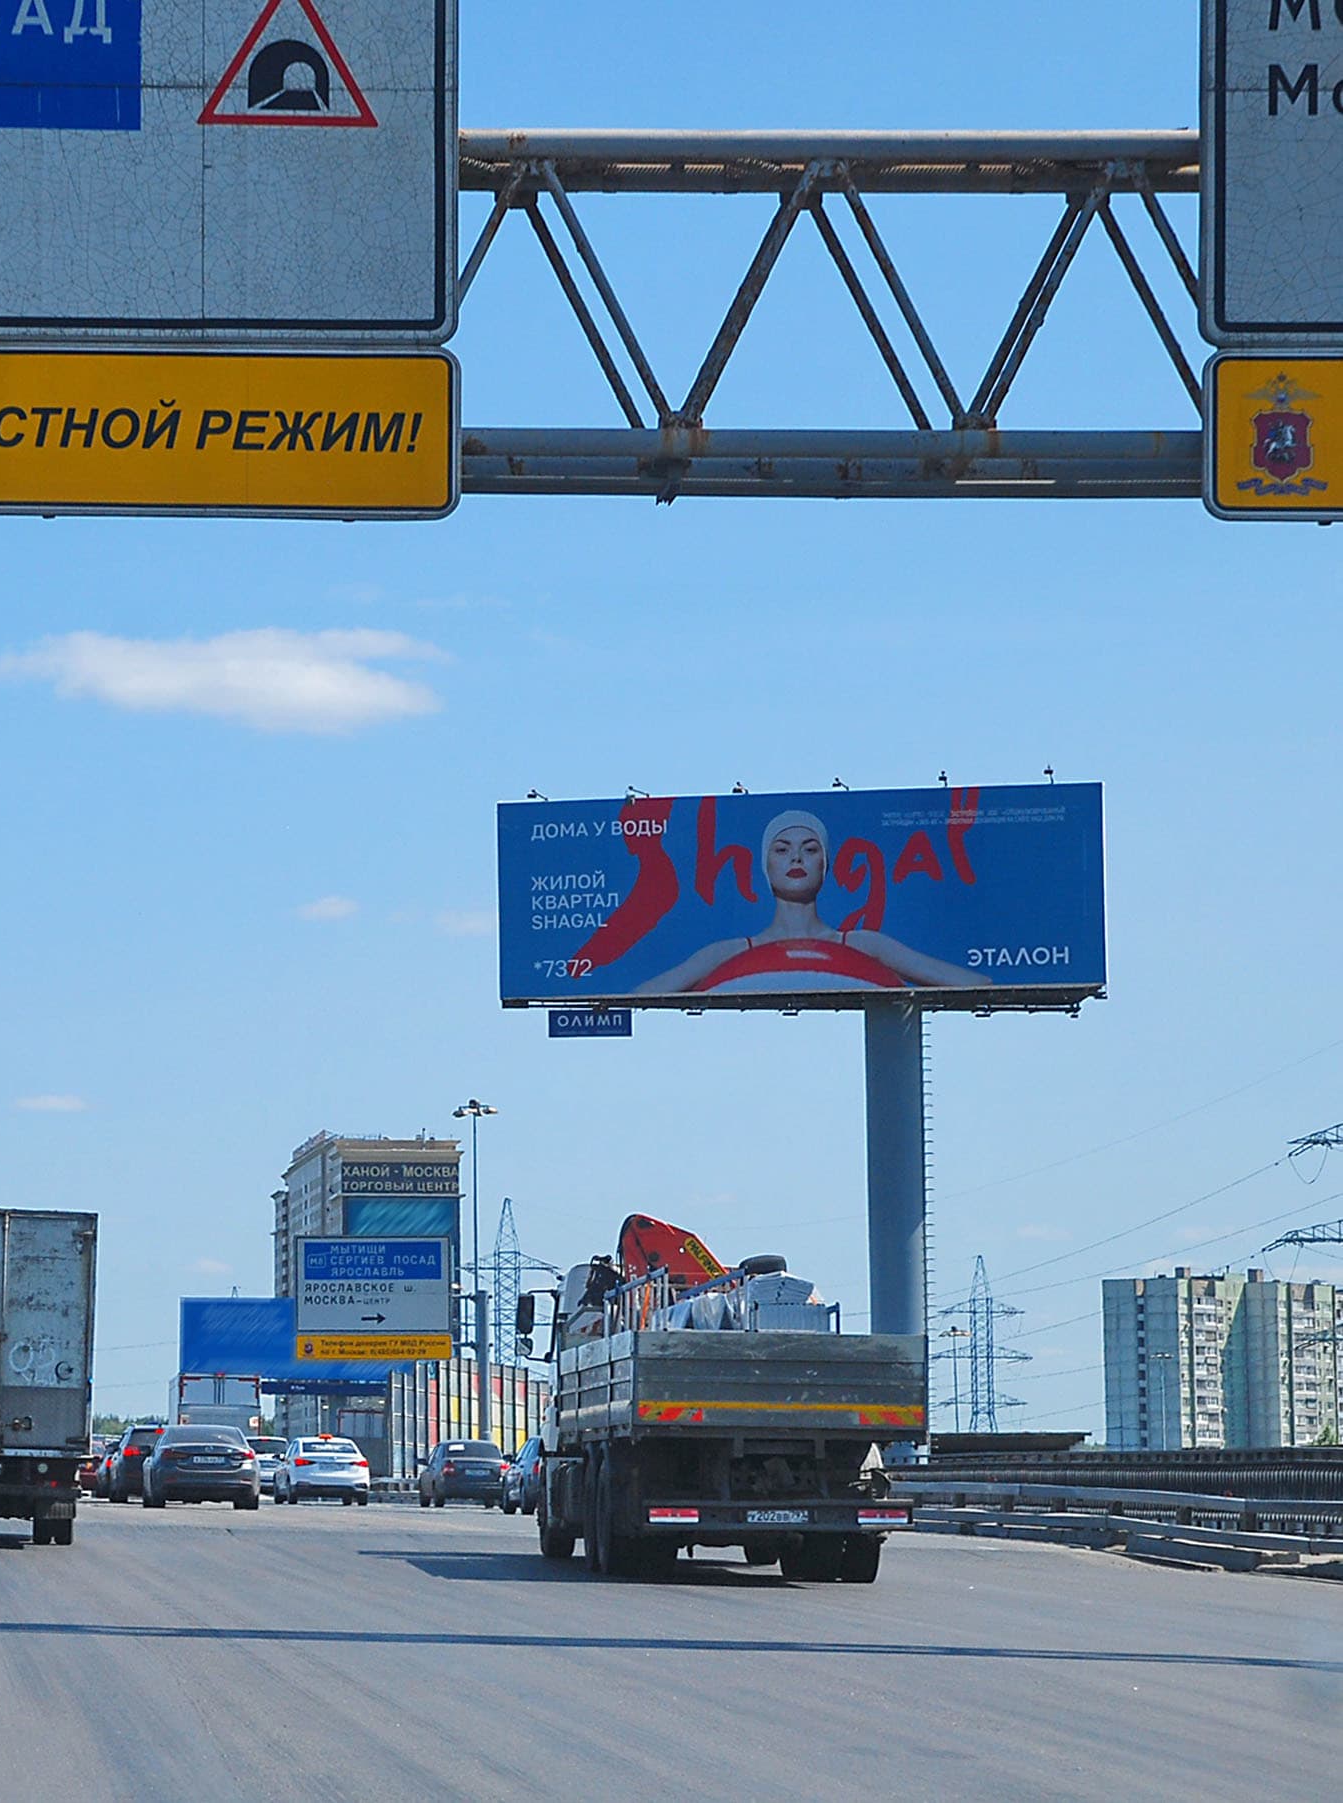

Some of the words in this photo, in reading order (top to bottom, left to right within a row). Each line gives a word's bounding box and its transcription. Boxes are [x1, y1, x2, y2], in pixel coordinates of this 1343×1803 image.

[196, 409, 423, 455] РЕЖИМ!
[531, 822, 589, 841] ДОМА
[592, 821, 606, 837] У
[611, 819, 668, 837] ВОДЫ
[531, 870, 606, 891] ЖИЛОЙ
[531, 892, 619, 911] КВАРТАЛ
[531, 912, 608, 930] SHAGAL
[967, 945, 1070, 967] ЭТАЛОН
[557, 1013, 622, 1027] ОЛИМП
[342, 1164, 390, 1177] ХАНОЙ
[401, 1164, 459, 1178] МОСКВА
[343, 1180, 414, 1191] ТОРГОВЫЙ
[417, 1181, 459, 1193] ЦЕНТР
[329, 1244, 386, 1255] МЫТИЩИ
[330, 1255, 385, 1265] СЕРГИЕВ
[393, 1255, 437, 1265] ПОСАД
[330, 1267, 405, 1277] ЯРОСЛАВЛЬ
[304, 1283, 395, 1293] ЯРОСЛАВСКОЕ
